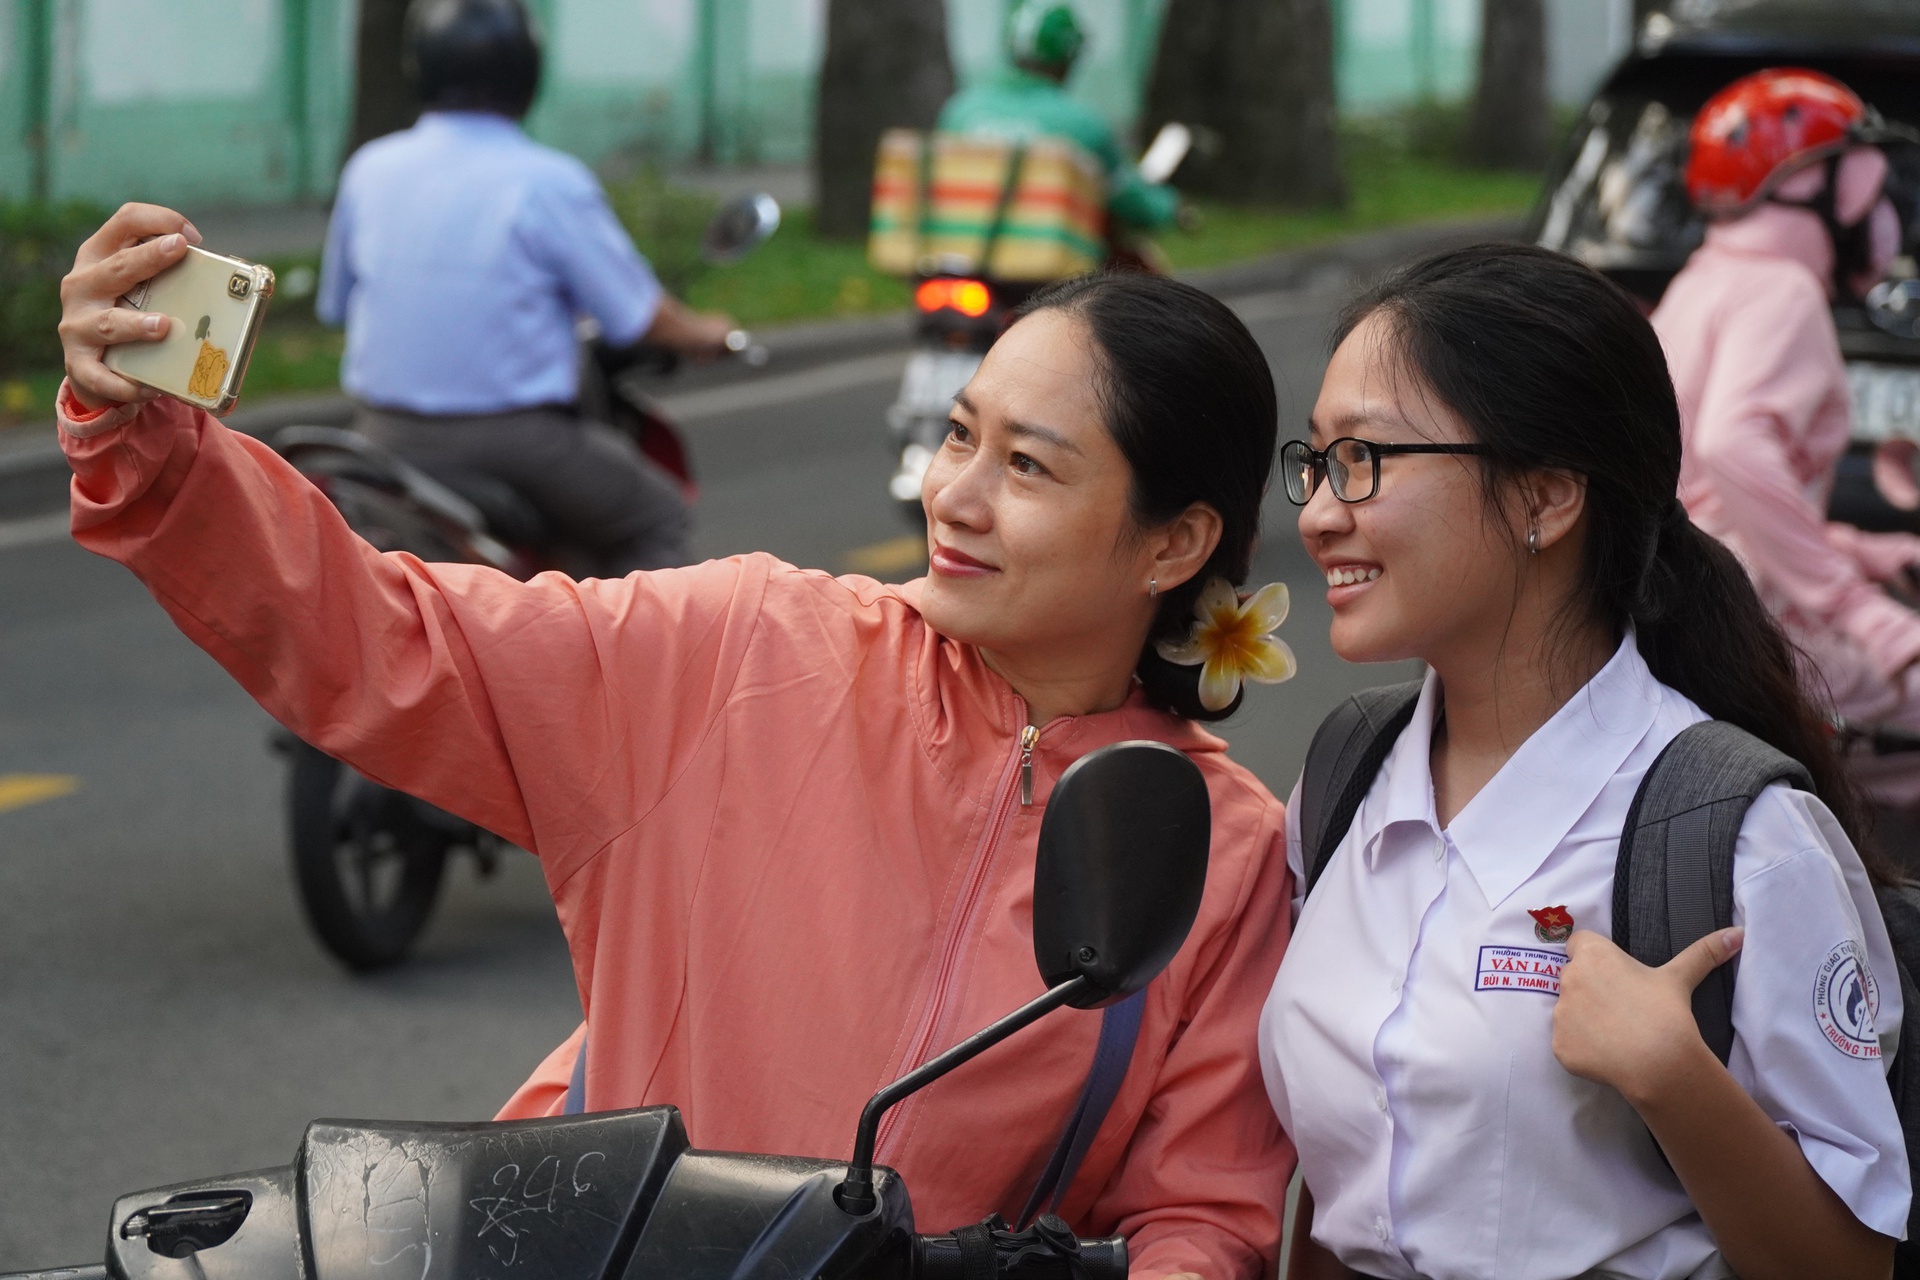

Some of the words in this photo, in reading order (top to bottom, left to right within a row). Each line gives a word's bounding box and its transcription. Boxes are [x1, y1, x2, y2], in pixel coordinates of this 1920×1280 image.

[1491, 957, 1529, 972] VĂN
[1492, 949, 1521, 957] TRƯỜNG
[1525, 952, 1548, 960] TRUNG
[1550, 956, 1564, 964] HỌC
[1483, 974, 1499, 986] BÙI
[1502, 976, 1513, 986] N.
[1517, 977, 1549, 989] THANH
[1552, 981, 1561, 991] V
[1816, 975, 1828, 1006] PHÒNG
[1823, 952, 1841, 973] GIÁO
[1824, 1023, 1860, 1055] TRƯỜNG
